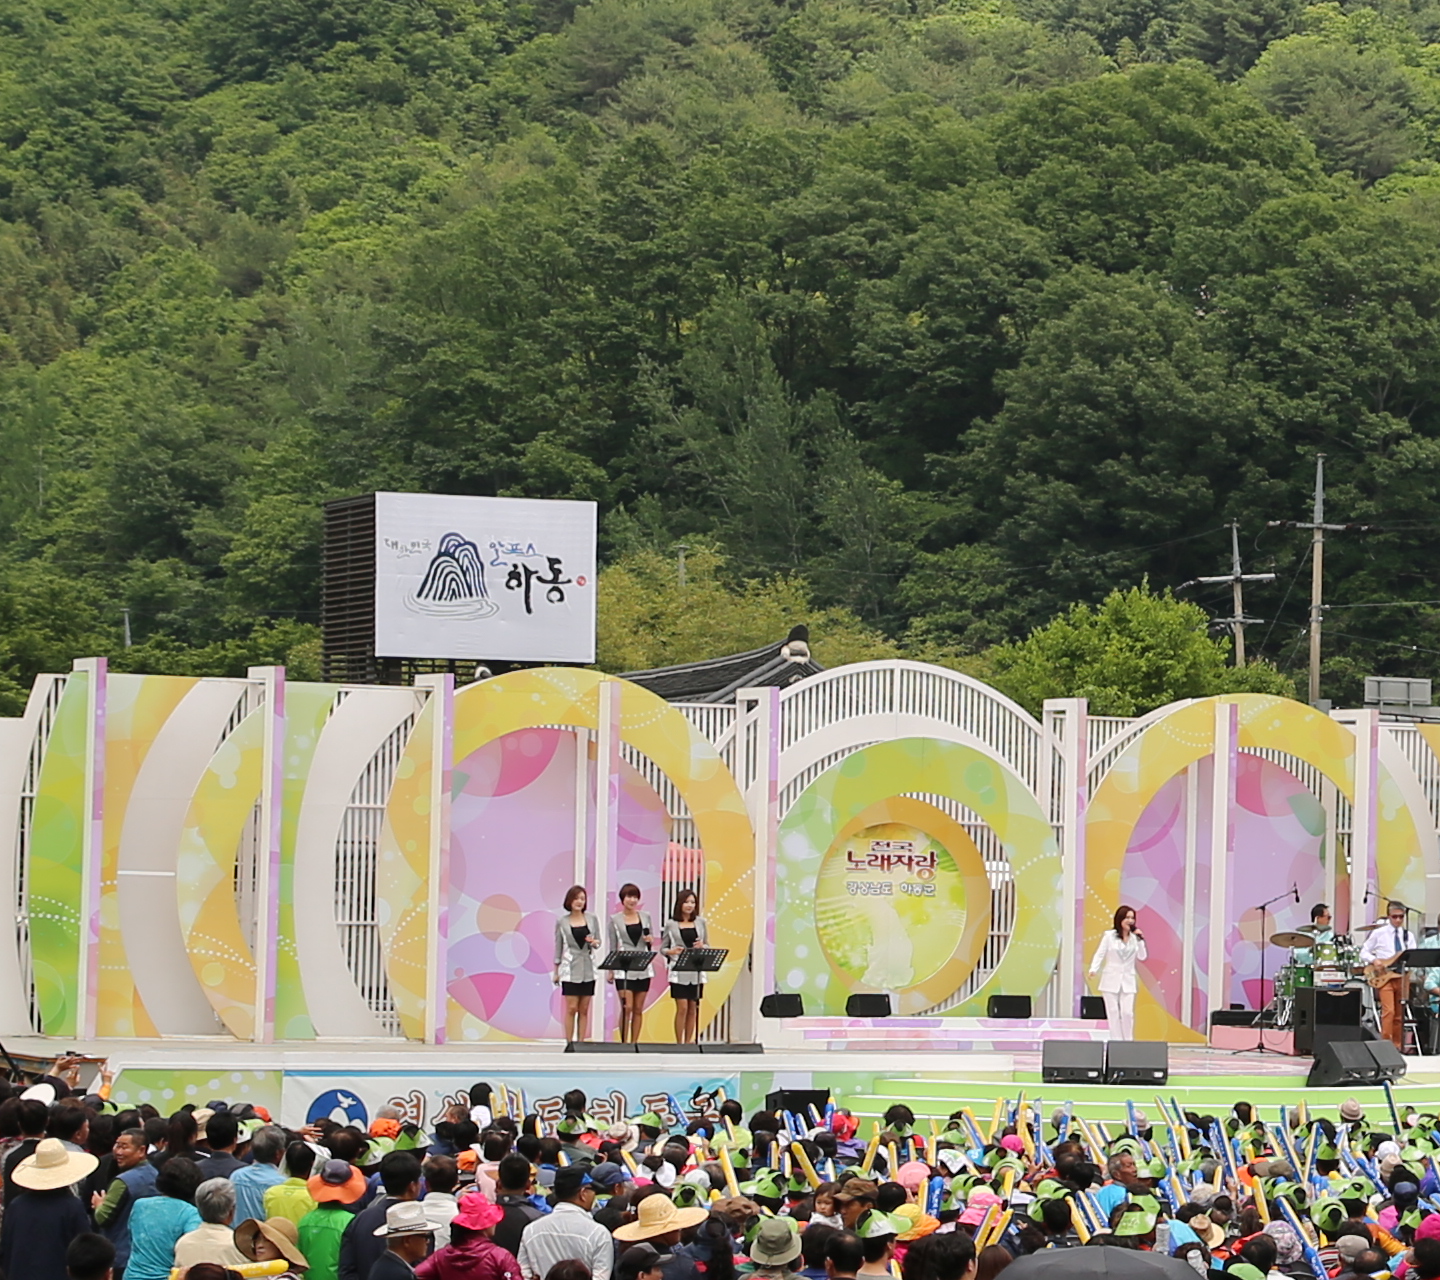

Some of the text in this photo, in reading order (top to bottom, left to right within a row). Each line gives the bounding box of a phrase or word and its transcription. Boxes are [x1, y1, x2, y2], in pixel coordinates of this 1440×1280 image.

[383, 537, 432, 559] 대한민국
[505, 556, 572, 615] 하동
[871, 841, 913, 852] 전국
[845, 850, 937, 880] 노래자랑
[846, 881, 936, 897] 경상남도 하동군
